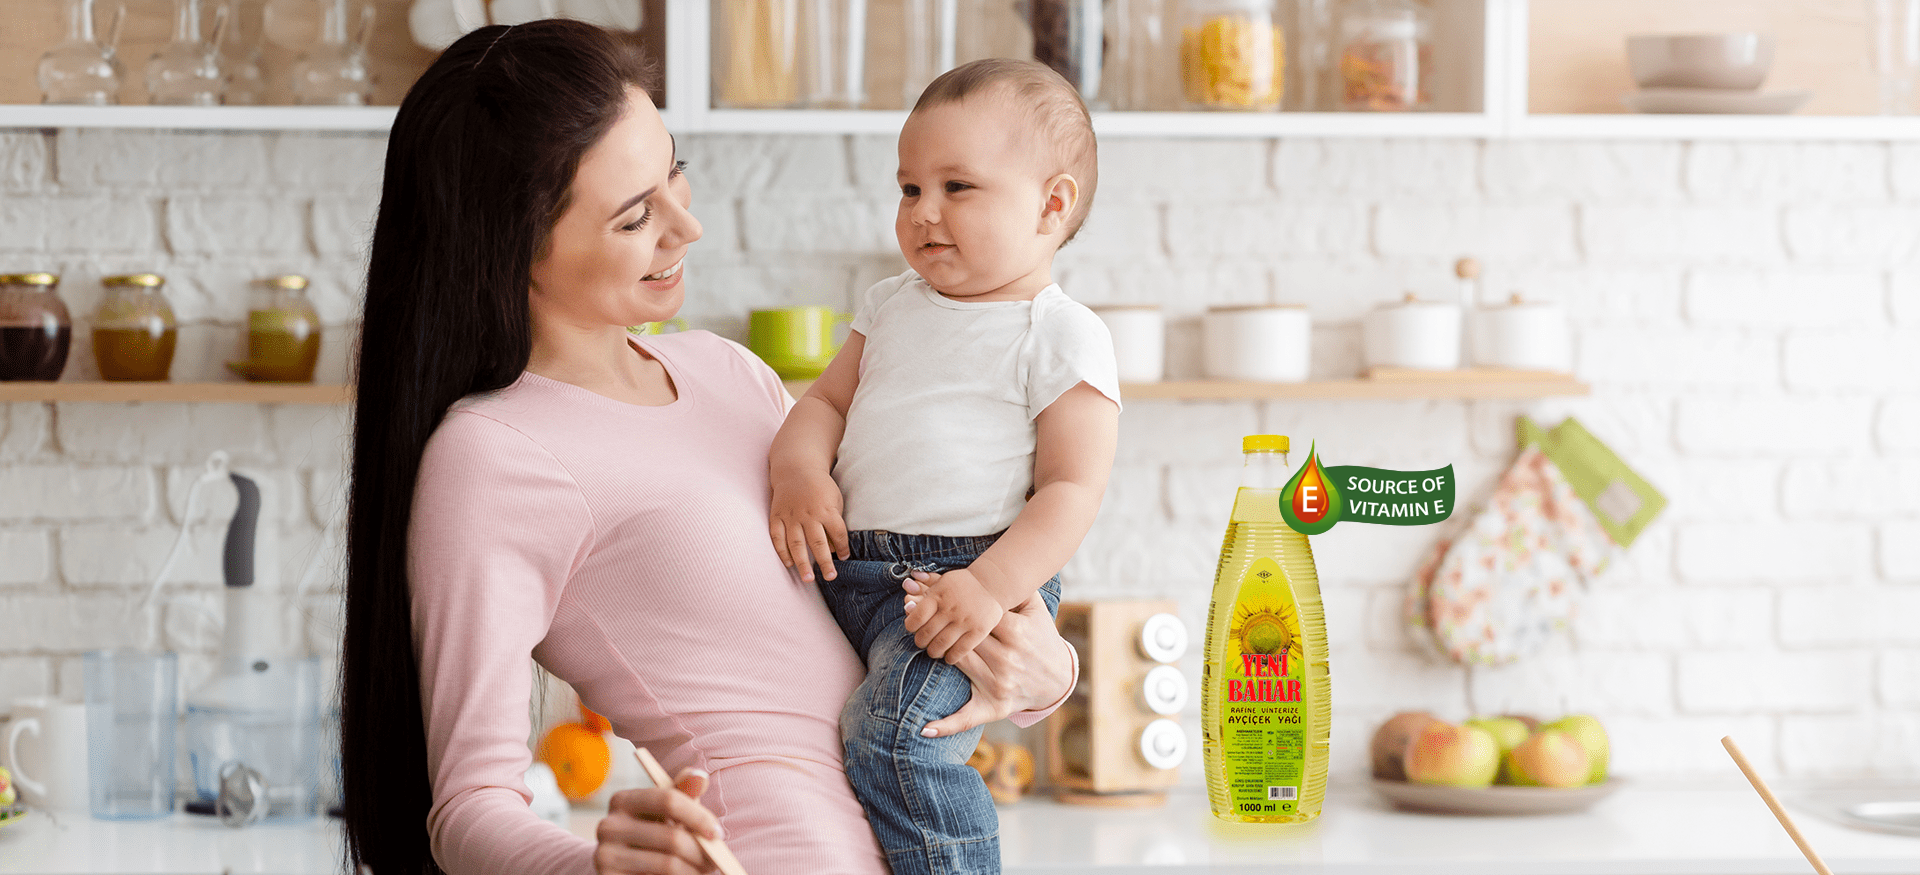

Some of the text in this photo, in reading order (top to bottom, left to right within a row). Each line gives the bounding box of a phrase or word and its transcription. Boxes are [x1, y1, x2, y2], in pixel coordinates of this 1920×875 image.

[1241, 648, 1289, 677] YENİ
[1227, 679, 1302, 703] BAHAR
[1228, 714, 1301, 726] AYÇİÇEK YAĞI
[1239, 803, 1261, 811] 1000
